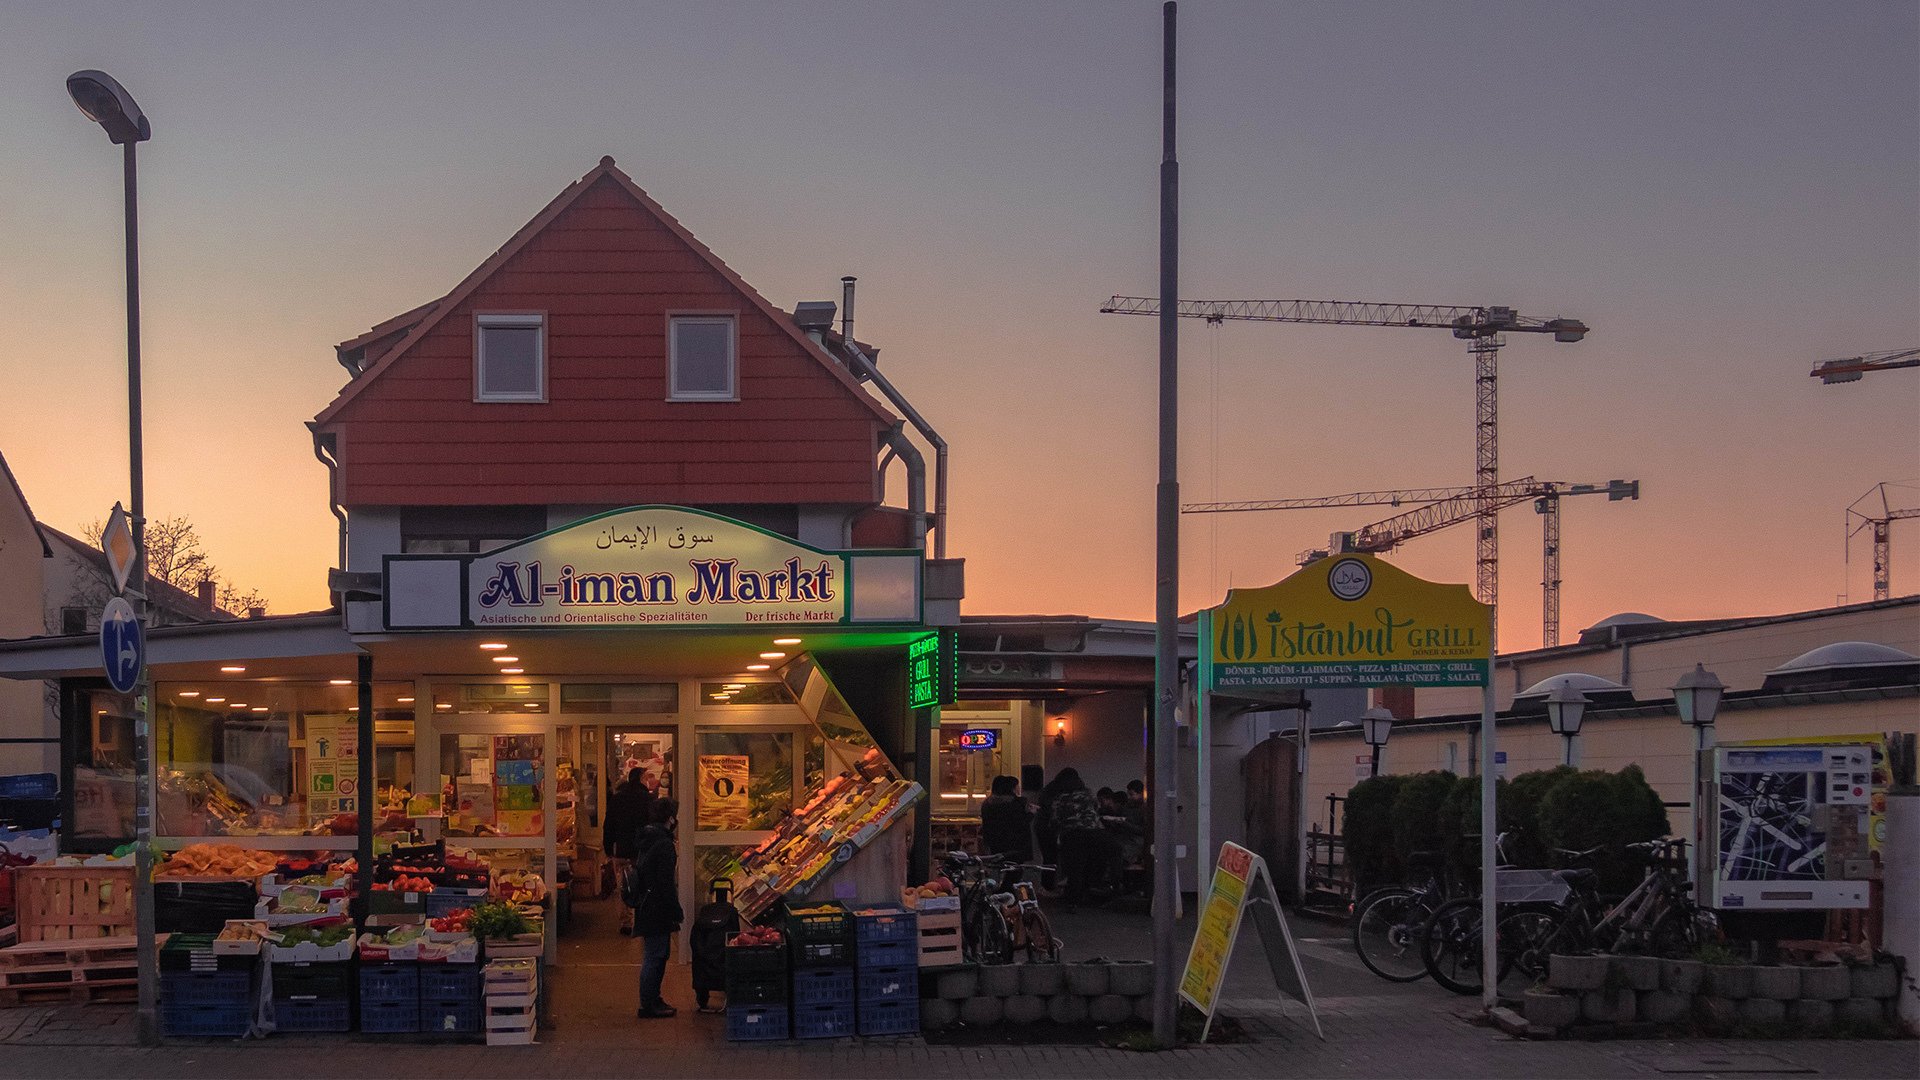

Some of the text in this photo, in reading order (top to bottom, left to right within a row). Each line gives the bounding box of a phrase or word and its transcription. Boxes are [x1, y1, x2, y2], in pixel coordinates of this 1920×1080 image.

[596, 525, 714, 550] سوق الإيمان
[478, 556, 835, 609] Al-iman Markt
[1336, 570, 1365, 585] حلال
[480, 611, 708, 624] Asiatische und Orientalische Spezialitäten
[746, 610, 834, 622] Der frische Markt
[1440, 648, 1448, 656] &
[1225, 665, 1256, 675] DÖNER
[1262, 664, 1295, 674] DÜRÜM
[1301, 665, 1353, 674] LAHMACUN
[1360, 664, 1384, 673] PIZZA
[1391, 662, 1441, 672] HÄHNCHEN
[1447, 663, 1476, 671] GRILL
[1219, 677, 1246, 686] PASTA
[1251, 676, 1313, 685] PANZAEROTTI
[1319, 675, 1352, 684] SUPPEN
[1359, 674, 1399, 683] BAKLAVA
[1405, 673, 1441, 682] KÜNEFE
[1447, 673, 1481, 681] SALATE
